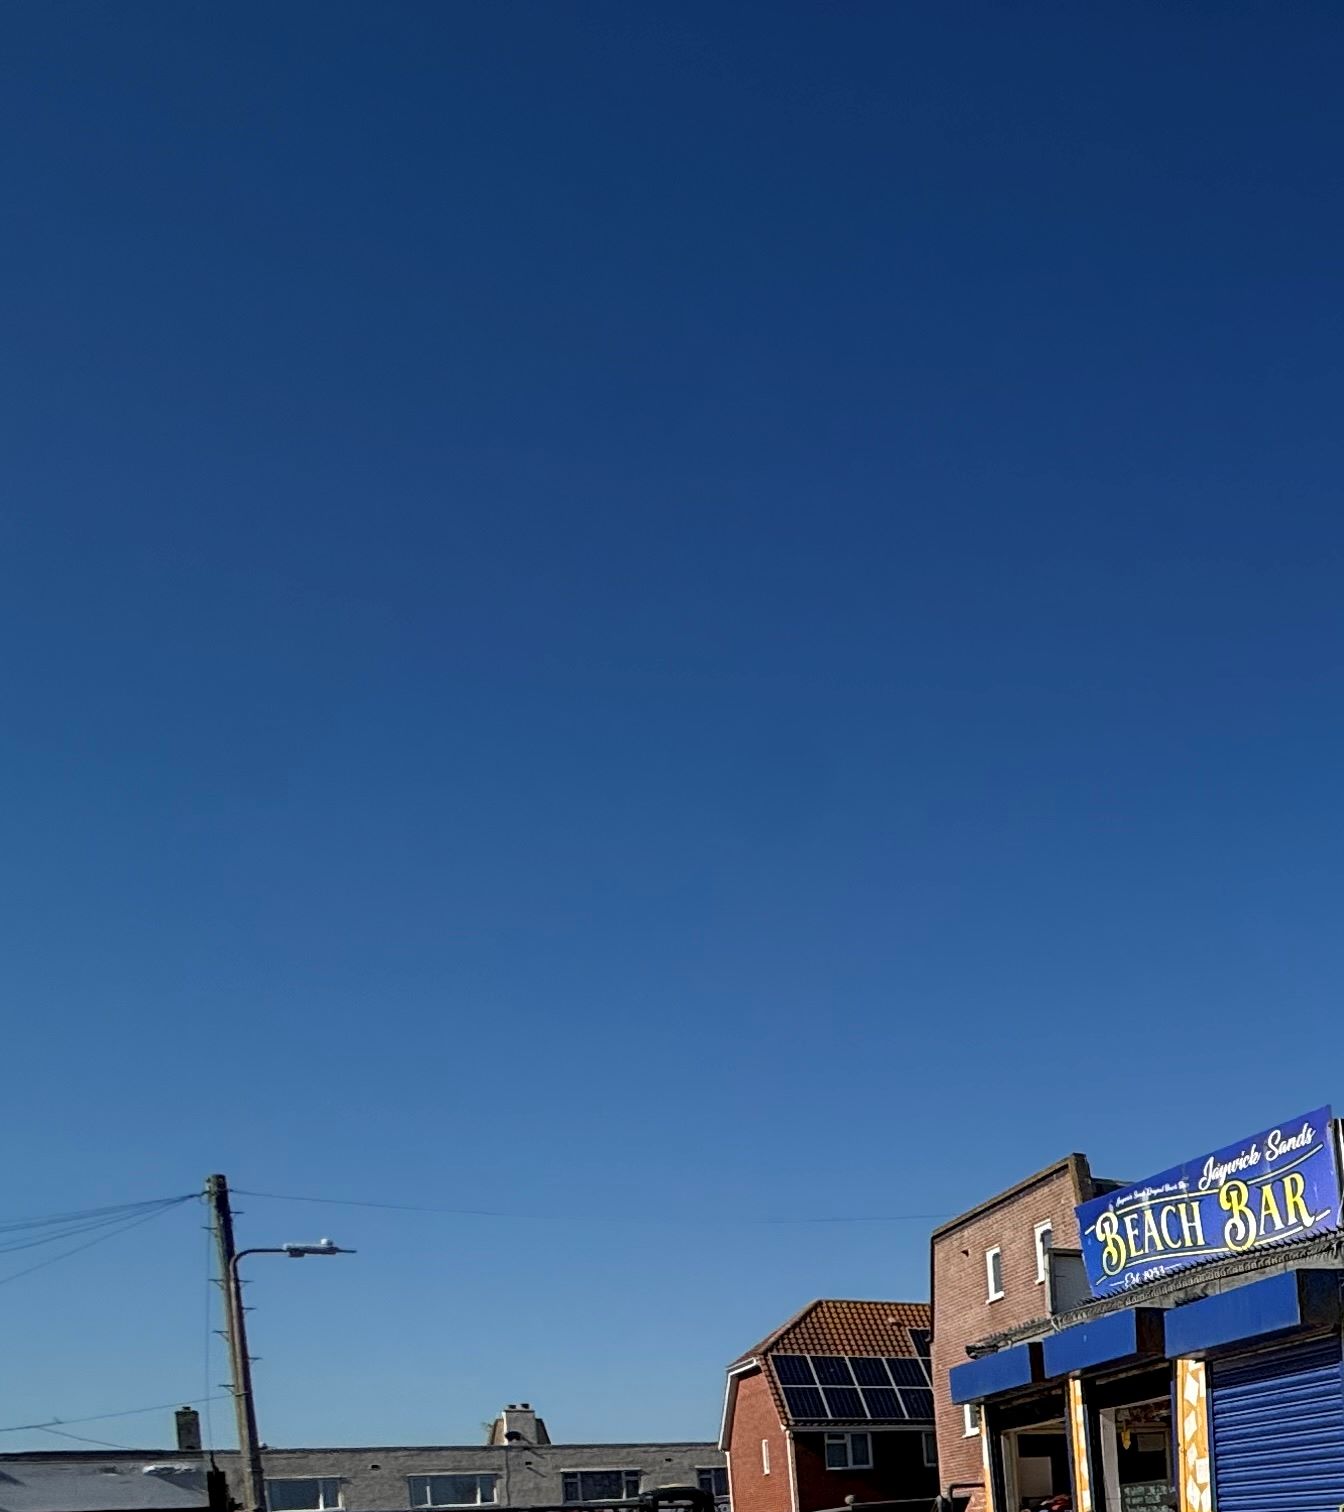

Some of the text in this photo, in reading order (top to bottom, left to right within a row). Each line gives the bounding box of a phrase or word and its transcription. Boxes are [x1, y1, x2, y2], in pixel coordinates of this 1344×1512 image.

[1199, 1122, 1316, 1190] Jaywick Sands
[1095, 1173, 1316, 1276] BEACH BAR
